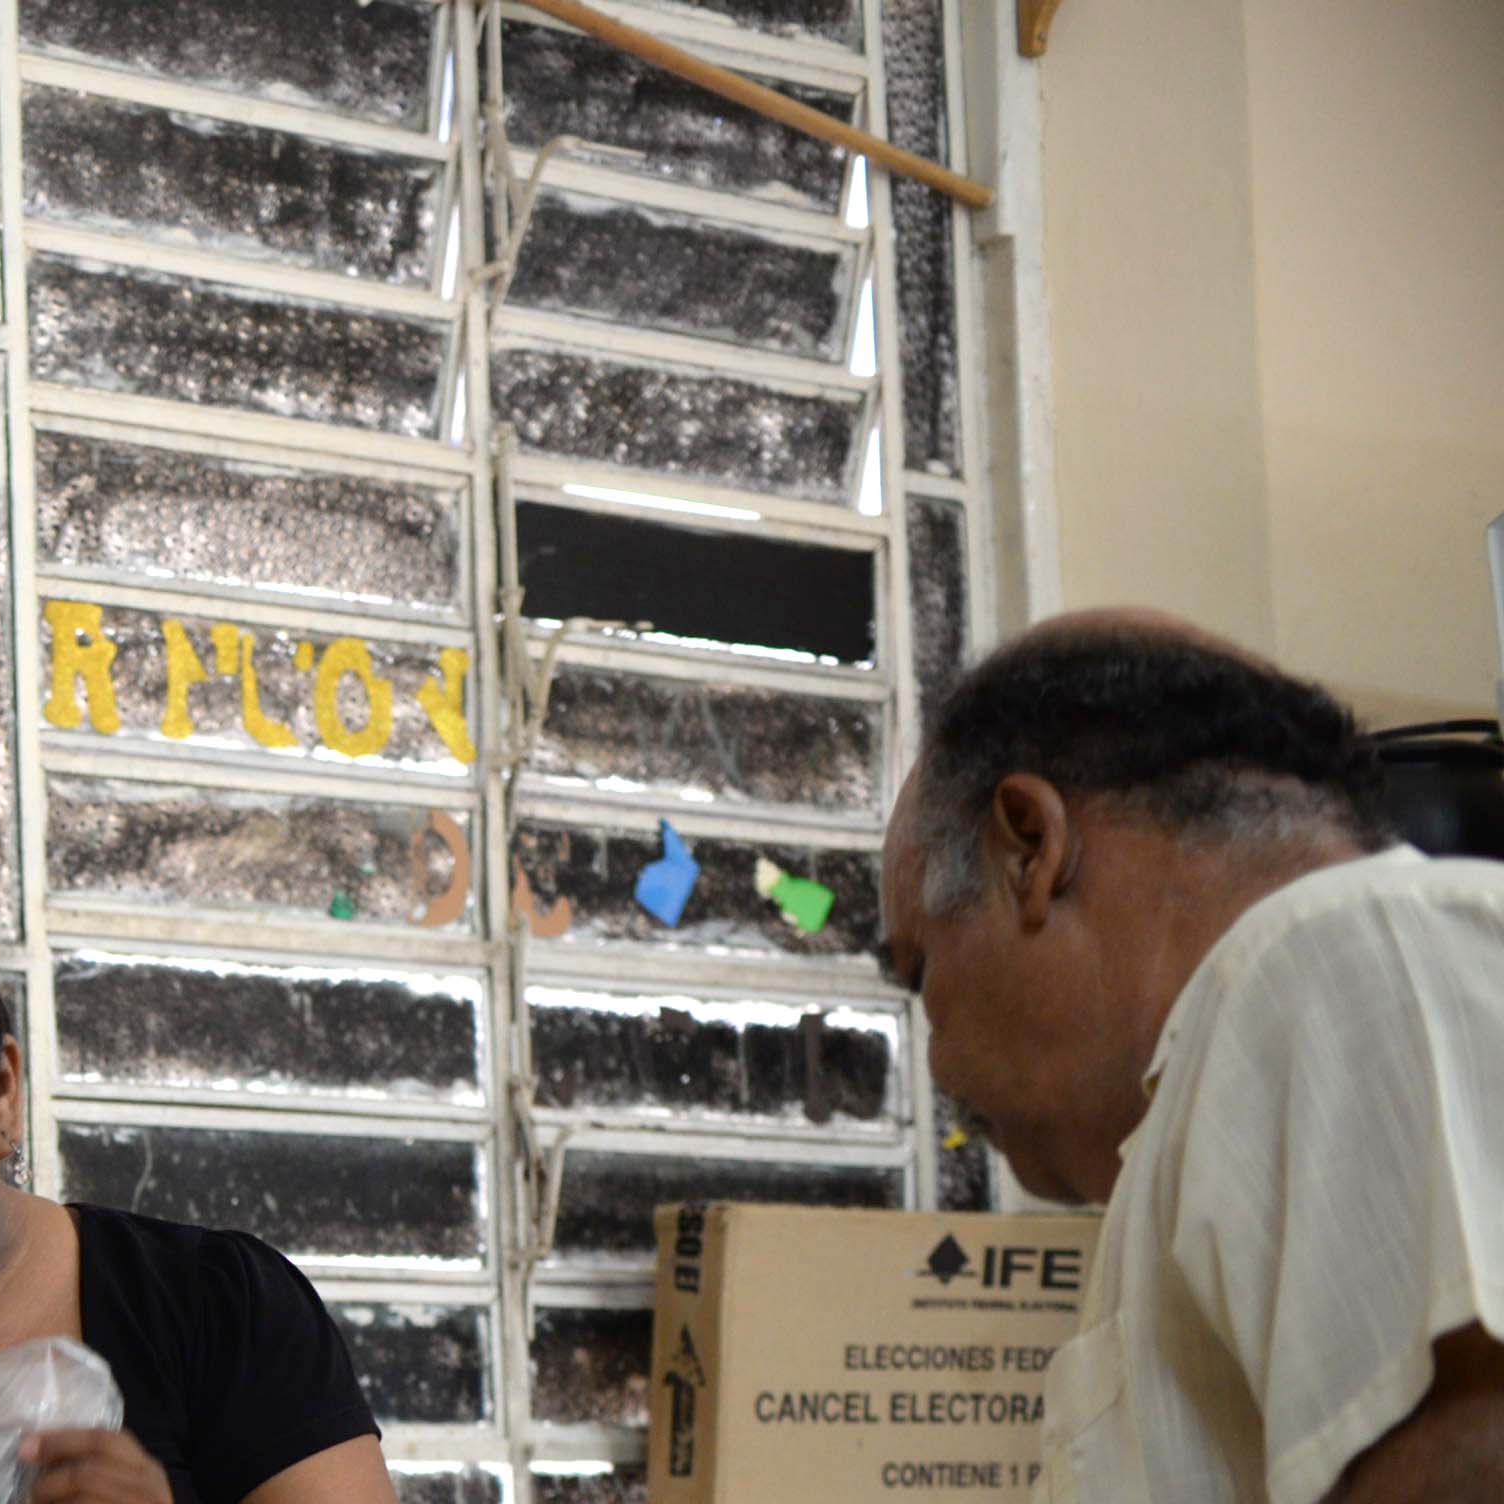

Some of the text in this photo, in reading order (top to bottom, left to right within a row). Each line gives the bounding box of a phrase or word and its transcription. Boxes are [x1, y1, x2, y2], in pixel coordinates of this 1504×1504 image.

[982, 1246, 1083, 1291] IFE
[844, 1346, 1058, 1372] ELECCIONES FED
[755, 1392, 1045, 1424] CANCEL ELECTORA
[882, 1462, 1001, 1488] CONTIENE
[1008, 1463, 1019, 1487] 1
